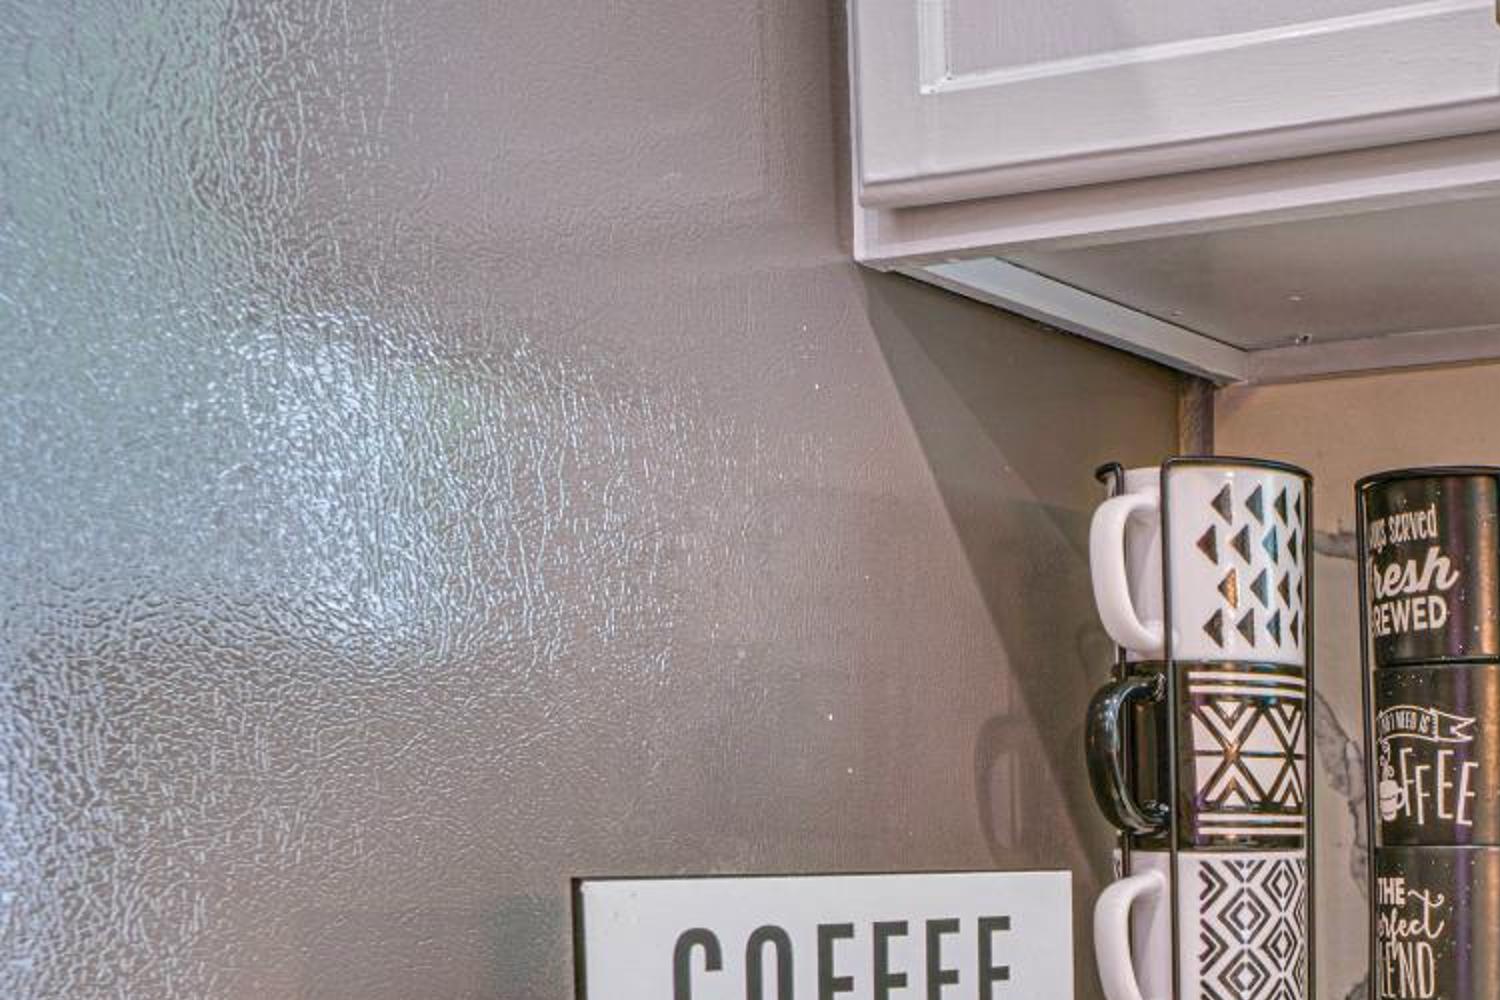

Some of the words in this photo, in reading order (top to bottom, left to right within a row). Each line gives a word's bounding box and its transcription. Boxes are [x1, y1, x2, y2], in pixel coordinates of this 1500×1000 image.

[1372, 546, 1459, 600] resh
[1373, 595, 1447, 636] REWED
[1377, 877, 1406, 905] THE
[1380, 941, 1435, 999] LEND
